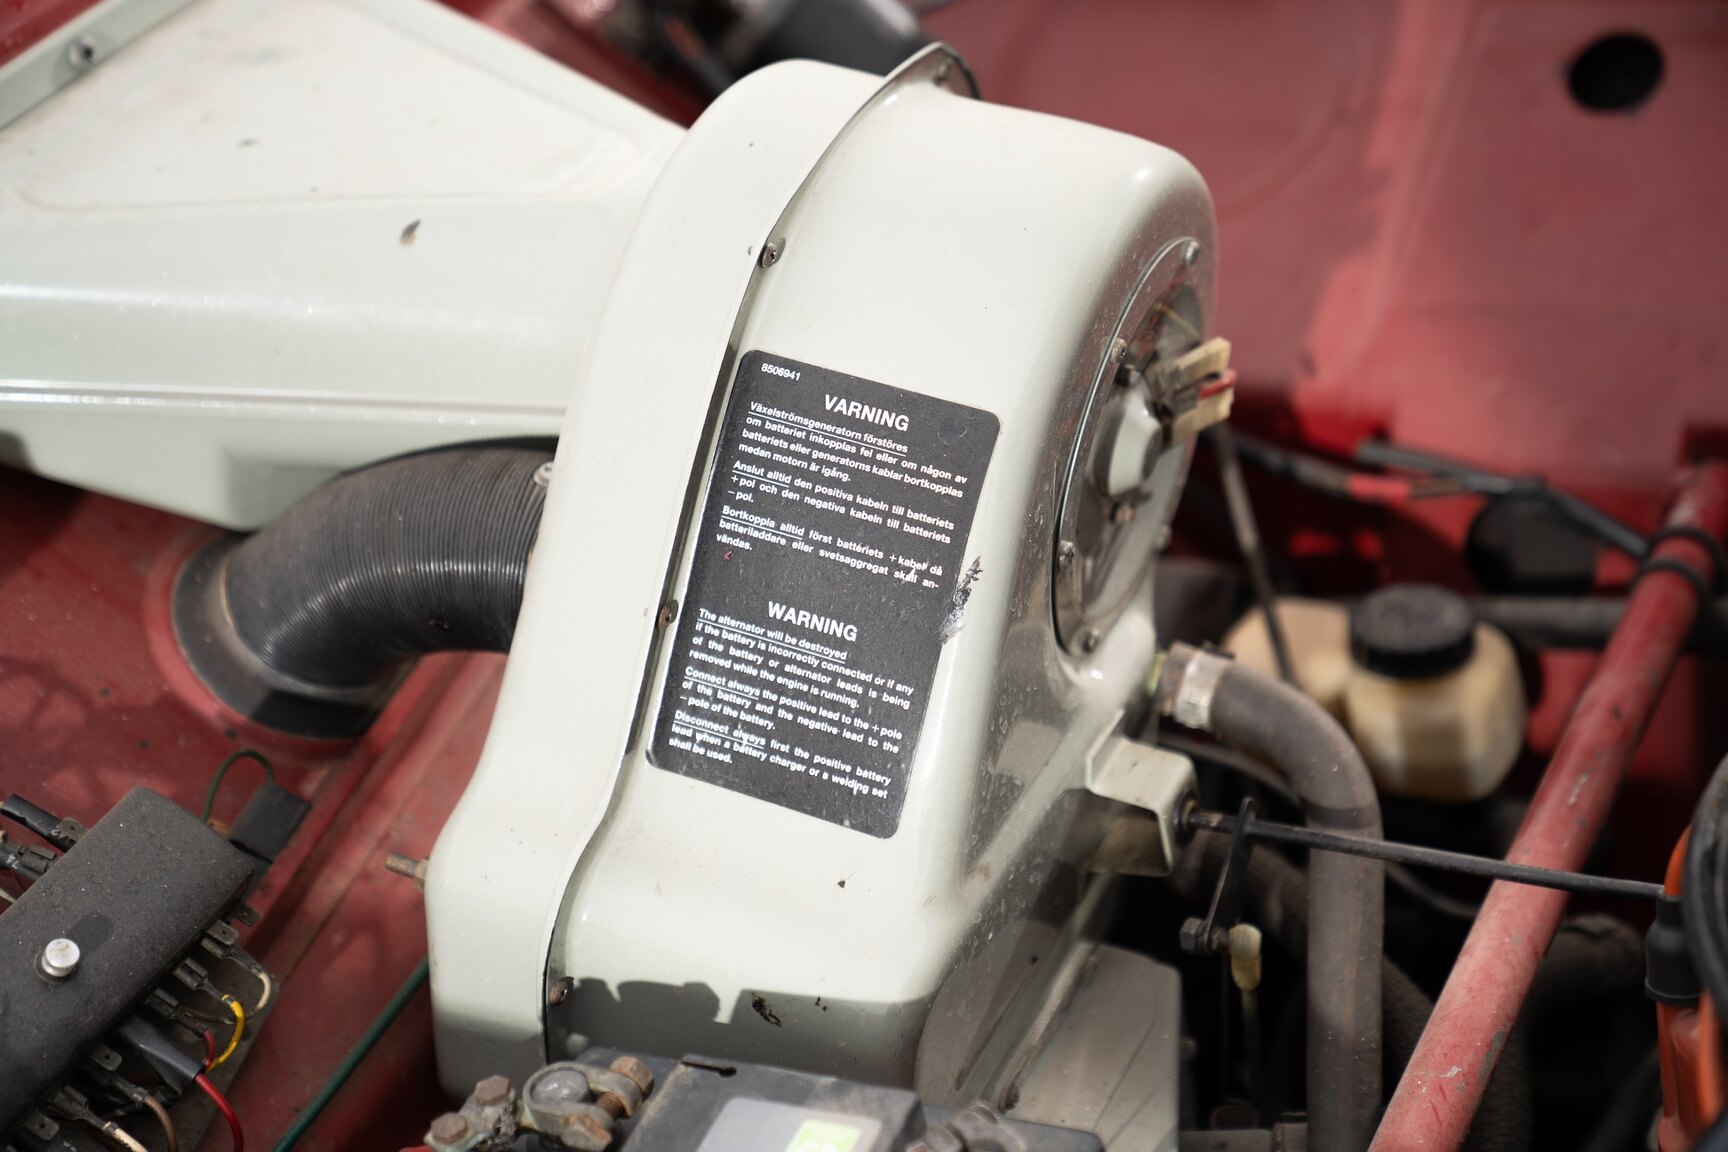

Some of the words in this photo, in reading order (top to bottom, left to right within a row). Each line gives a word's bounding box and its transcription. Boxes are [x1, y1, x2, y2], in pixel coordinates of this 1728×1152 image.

[761, 363, 801, 381] 8506941
[751, 401, 862, 440] Växelströmsgeneratorn
[863, 433, 908, 453] förstöres
[825, 394, 910, 432] VARNING
[738, 443, 772, 459] medan
[772, 453, 808, 469] motorn
[809, 461, 821, 472] är
[821, 465, 851, 482] igång.
[742, 428, 789, 449] batteriets
[789, 443, 812, 455] eller
[811, 450, 871, 472] generatorns
[871, 464, 904, 481] kablar
[903, 473, 964, 498] bortkopplas
[746, 417, 762, 427] om
[764, 420, 807, 439] batteriet
[809, 432, 857, 453] inkopplas
[860, 447, 874, 458] fel
[875, 452, 899, 465] eller
[901, 460, 918, 470] om
[920, 465, 952, 480] någon
[954, 475, 968, 484] av
[733, 461, 765, 476] Anslut
[766, 471, 792, 484] alltid
[794, 478, 813, 490] den
[814, 484, 854, 502] positiva
[856, 494, 889, 512] kabeln
[892, 505, 905, 516] till
[906, 509, 954, 530] batteriets
[759, 483, 778, 495] och
[781, 489, 800, 501] den
[804, 496, 846, 514] negativa
[849, 507, 883, 525] kabeln
[886, 518, 900, 529] till
[903, 522, 951, 544] batteriets
[716, 534, 752, 551] vändas.
[719, 519, 787, 546] batteriladdare
[791, 541, 814, 553] eller
[818, 549, 889, 575] svetsaggregat
[893, 570, 918, 583] skall
[922, 579, 939, 589] an-
[722, 505, 776, 528] Bortkoppla
[780, 522, 805, 536] alltid
[808, 530, 833, 544] först
[836, 538, 884, 559] batteriets
[929, 566, 943, 576] då
[699, 609, 717, 621] The
[717, 615, 766, 635] alternator
[766, 629, 784, 641] will
[784, 634, 798, 645] be
[797, 639, 848, 660] destroyed
[768, 600, 858, 642] WARNING
[689, 649, 732, 668] removed
[733, 662, 758, 676] while
[759, 670, 776, 682] the
[776, 676, 809, 692] engine
[810, 685, 820, 695] is
[820, 689, 860, 708] running.
[692, 636, 704, 646] of
[708, 640, 724, 652] the
[728, 646, 764, 665] battery
[768, 659, 780, 668] or
[784, 664, 832, 684] alternator
[836, 678, 863, 695] leads
[868, 688, 878, 699] is
[882, 692, 911, 710] being
[695, 622, 703, 632] if
[704, 625, 720, 637] the
[721, 630, 756, 649] battery
[757, 640, 766, 650] is
[768, 644, 820, 668] incorrectly
[821, 661, 873, 683] connected
[874, 676, 886, 686] or
[886, 679, 895, 689] if
[895, 683, 914, 696] any
[682, 680, 694, 690] of
[697, 684, 713, 698] the
[716, 690, 752, 709] battery
[755, 702, 774, 715] and
[777, 708, 794, 721] the
[797, 716, 841, 735] negative
[842, 728, 864, 743] lead
[868, 736, 879, 747] to
[882, 741, 899, 754] the
[685, 667, 727, 688] Connect
[726, 680, 761, 697] always
[762, 690, 778, 702] the
[779, 696, 818, 714] positive
[818, 707, 840, 721] lead
[841, 714, 852, 725] to
[853, 717, 870, 730] the
[710, 703, 722, 713] of
[722, 706, 739, 718] the
[739, 710, 776, 730] battery.
[668, 738, 692, 751] shall
[692, 743, 706, 755] be
[706, 749, 732, 764] used.
[671, 723, 694, 737] lead
[695, 731, 722, 746] when
[723, 740, 731, 749] a
[732, 742, 768, 762] battery
[769, 755, 807, 772] charger
[808, 768, 820, 777] or
[822, 771, 829, 780] a
[831, 774, 870, 794] welding
[871, 787, 888, 799] set
[674, 710, 729, 736] Disconnect
[732, 729, 766, 747] always
[770, 740, 790, 753] first
[794, 747, 810, 760] the
[813, 754, 852, 773] positive
[855, 766, 892, 786] battery
